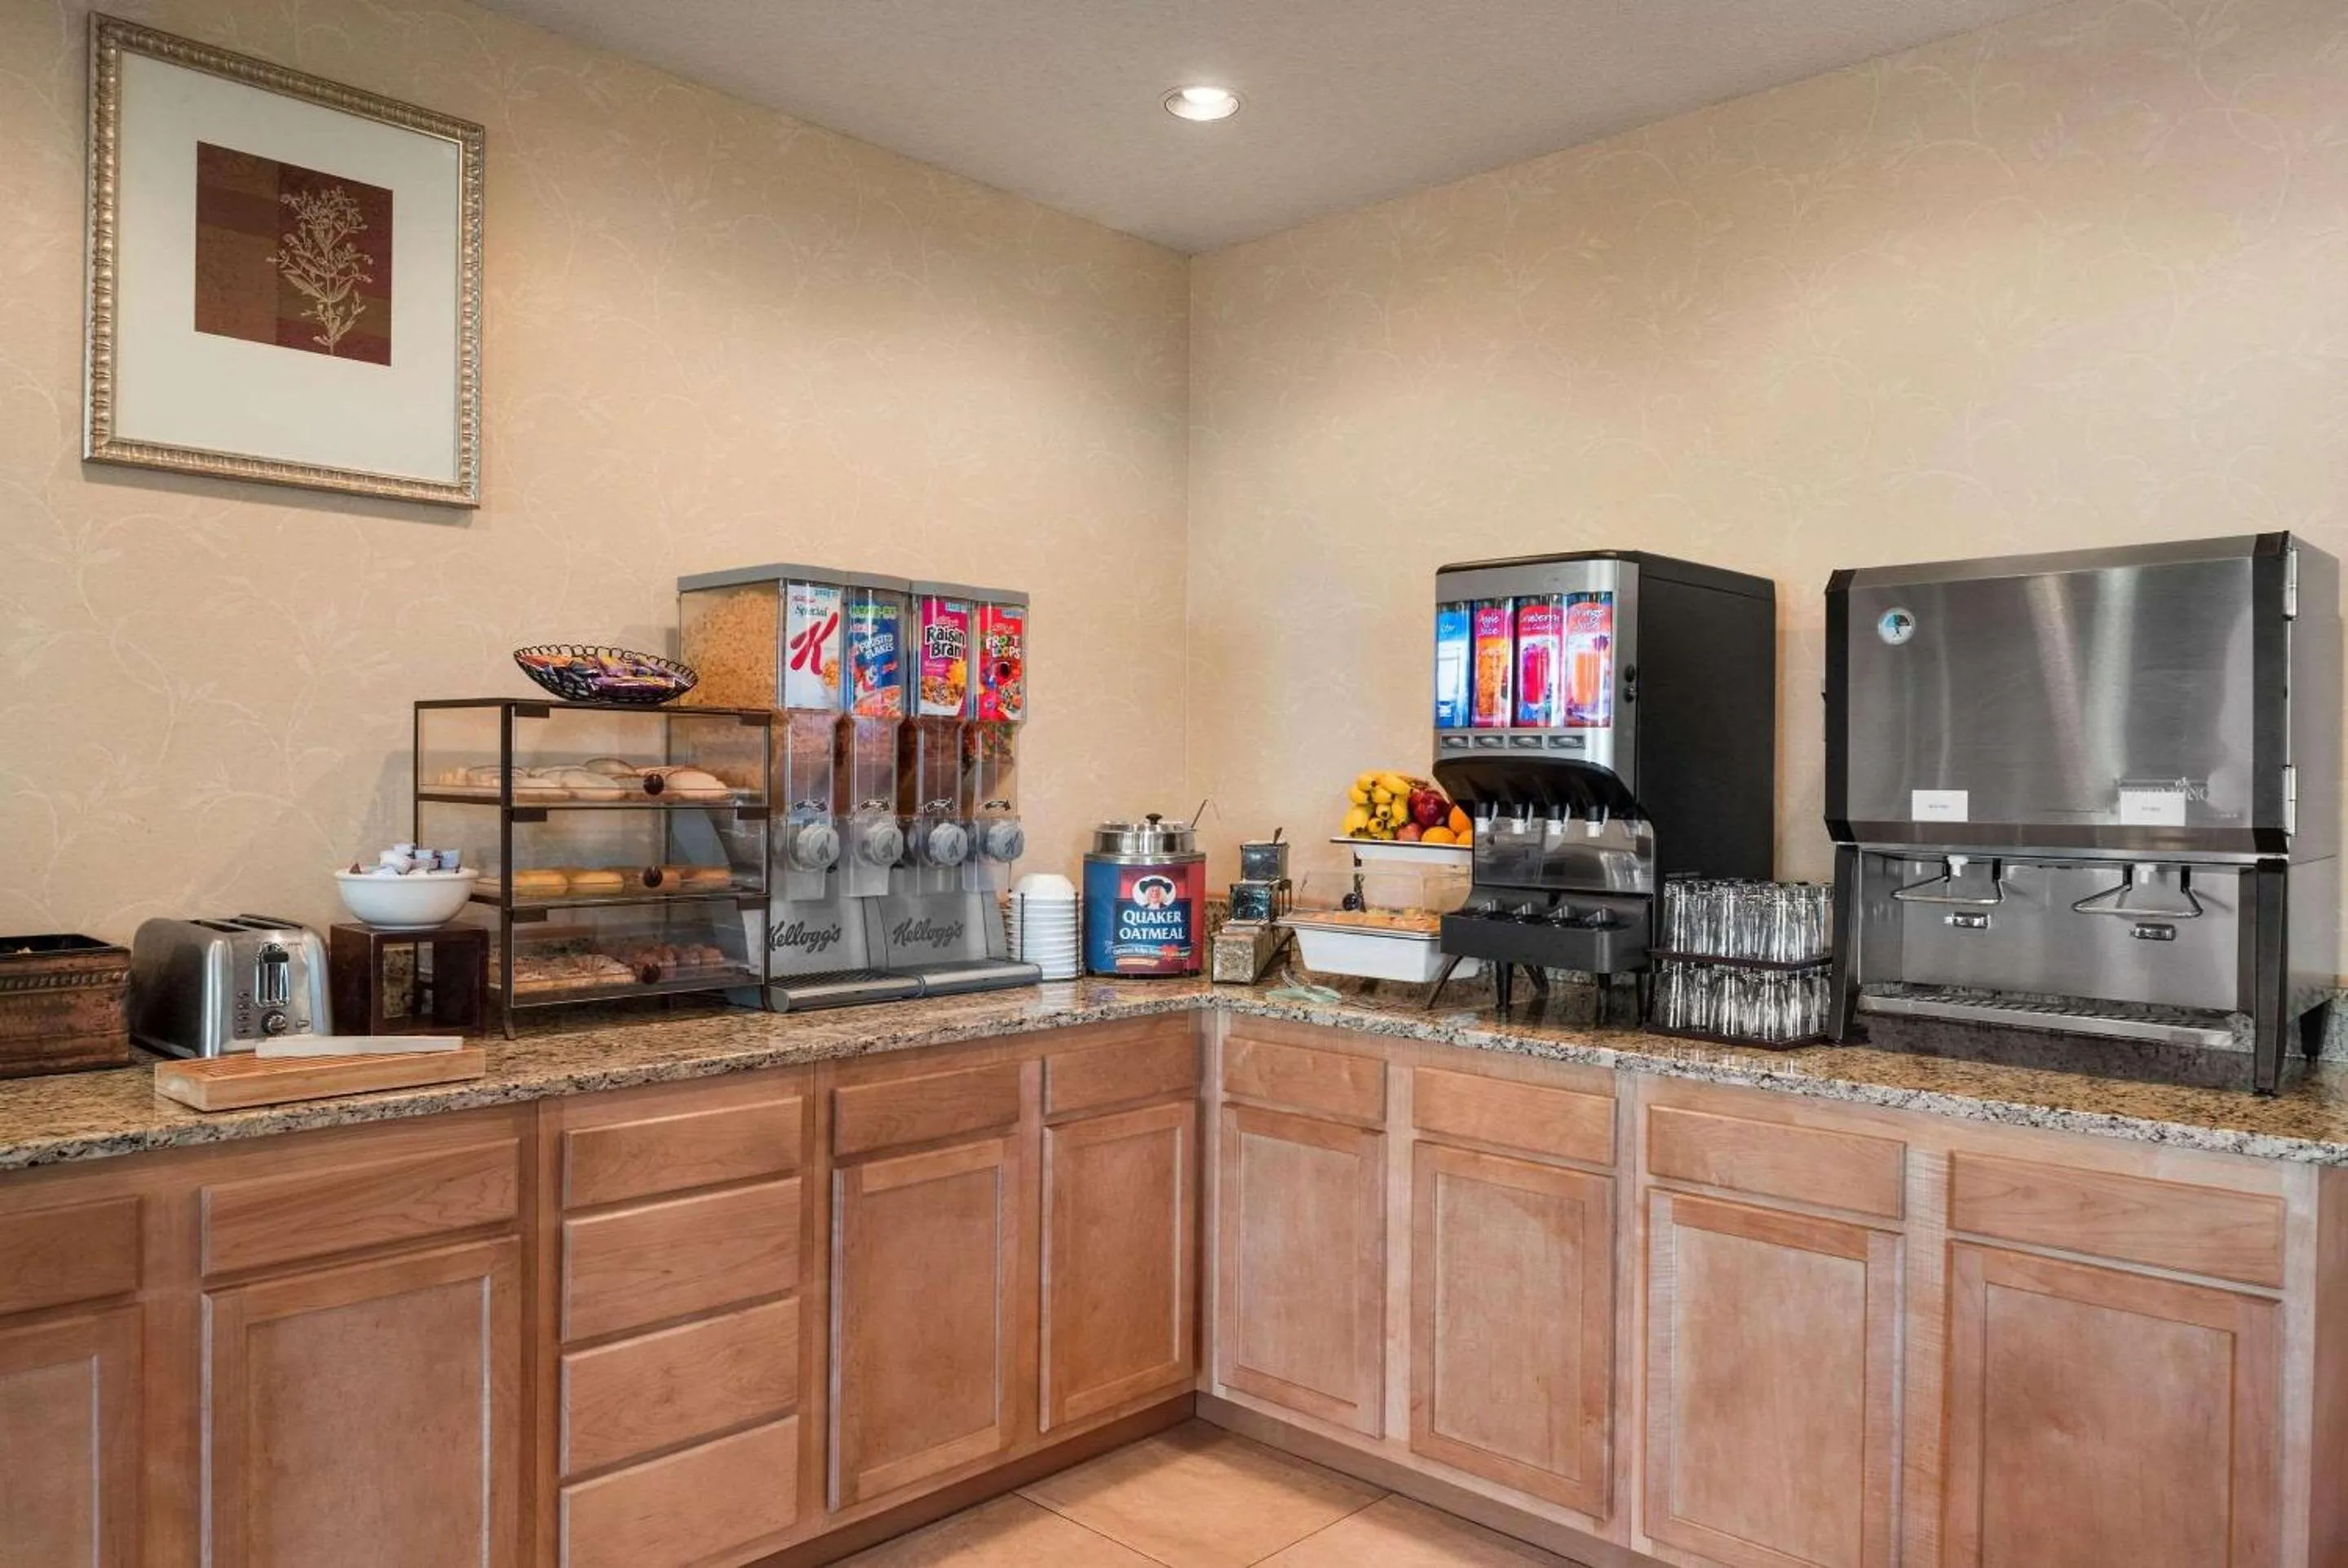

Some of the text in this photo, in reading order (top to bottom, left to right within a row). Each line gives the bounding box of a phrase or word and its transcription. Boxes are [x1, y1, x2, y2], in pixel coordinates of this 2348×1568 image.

[790, 612, 838, 675] K
[925, 625, 966, 647] Raisin
[931, 643, 961, 658] Bran
[1122, 909, 1182, 925] QUAKER
[893, 917, 964, 947] Kellogg's
[1119, 927, 1186, 940] OATMEAL
